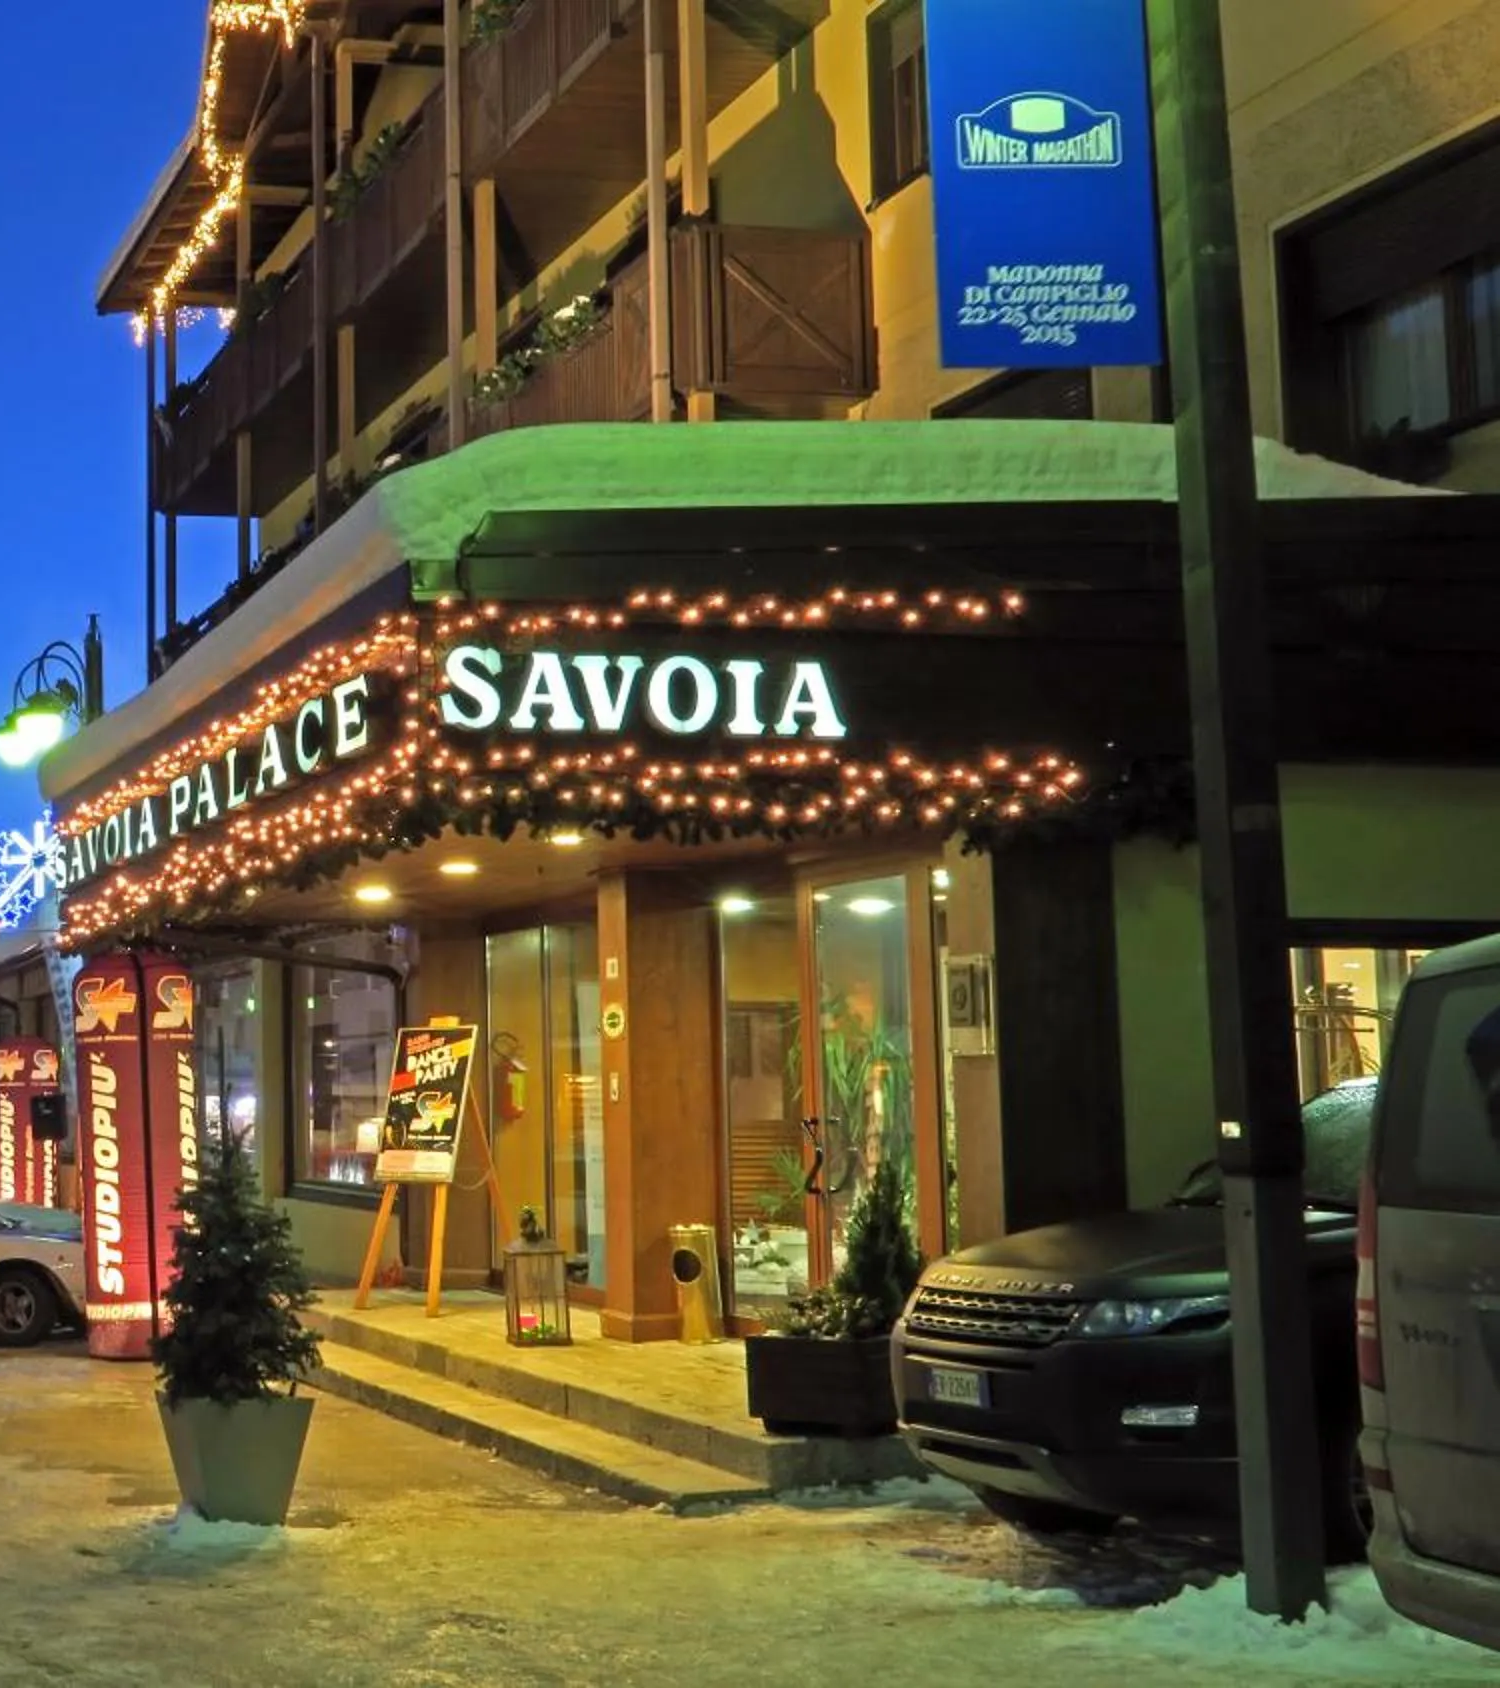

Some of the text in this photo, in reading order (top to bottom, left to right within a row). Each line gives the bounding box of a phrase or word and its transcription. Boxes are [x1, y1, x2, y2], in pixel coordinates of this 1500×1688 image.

[964, 118, 1114, 163] WINTER MARATHON
[1020, 324, 1077, 346] 2015
[439, 645, 848, 738] SAVOIA
[53, 673, 370, 889] SAVOIA PALACE
[415, 1059, 458, 1086] PARTY
[996, 1277, 1075, 1294] ROVER
